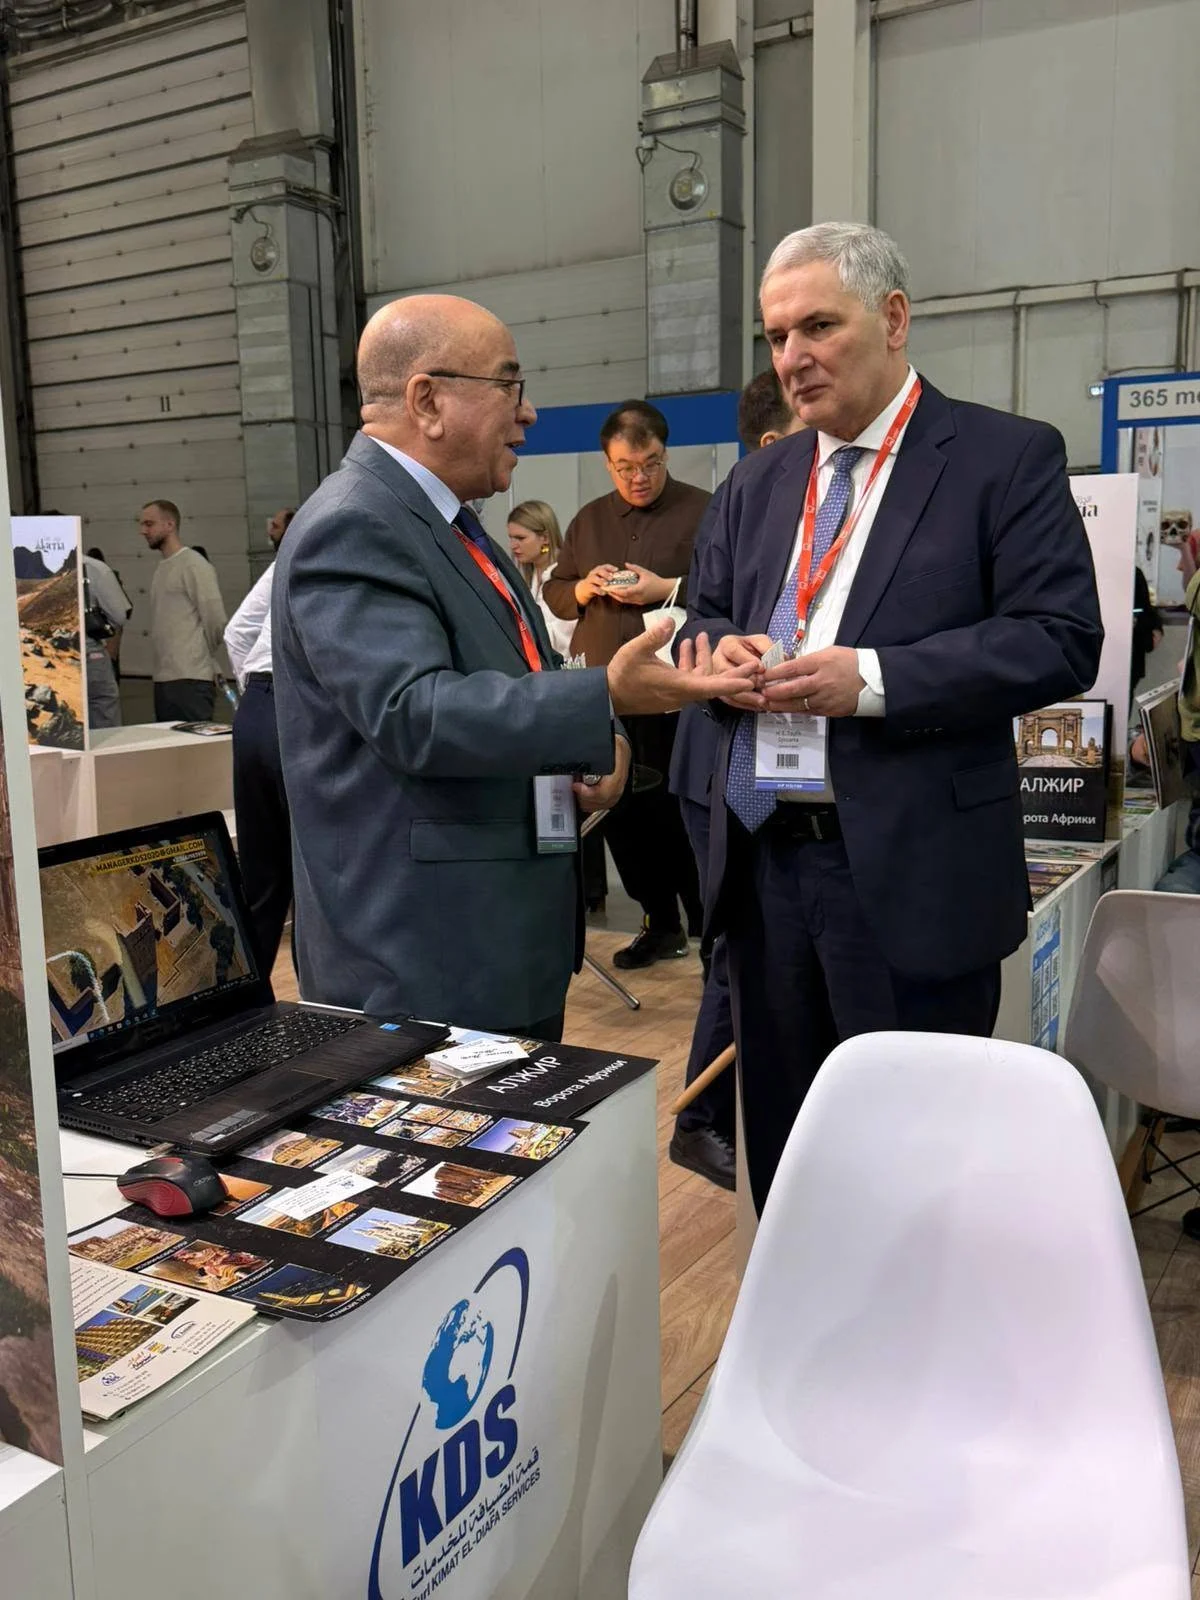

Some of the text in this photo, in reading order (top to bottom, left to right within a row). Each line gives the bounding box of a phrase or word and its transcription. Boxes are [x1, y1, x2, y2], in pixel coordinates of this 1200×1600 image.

[1129, 388, 1168, 408] 365
[1020, 777, 1085, 793] АЛЖИР
[1023, 813, 1097, 826] рота Африки
[486, 1056, 561, 1094] АЛЖИР
[533, 1060, 628, 1108] Ворота Африки
[400, 1384, 518, 1569] KDS
[411, 1446, 540, 1590] قمة الضيافة للخدمات
[431, 1550, 461, 1592] KIMAT
[462, 1508, 501, 1560] EL-DIAFA
[502, 1467, 541, 1517] SERVICES
